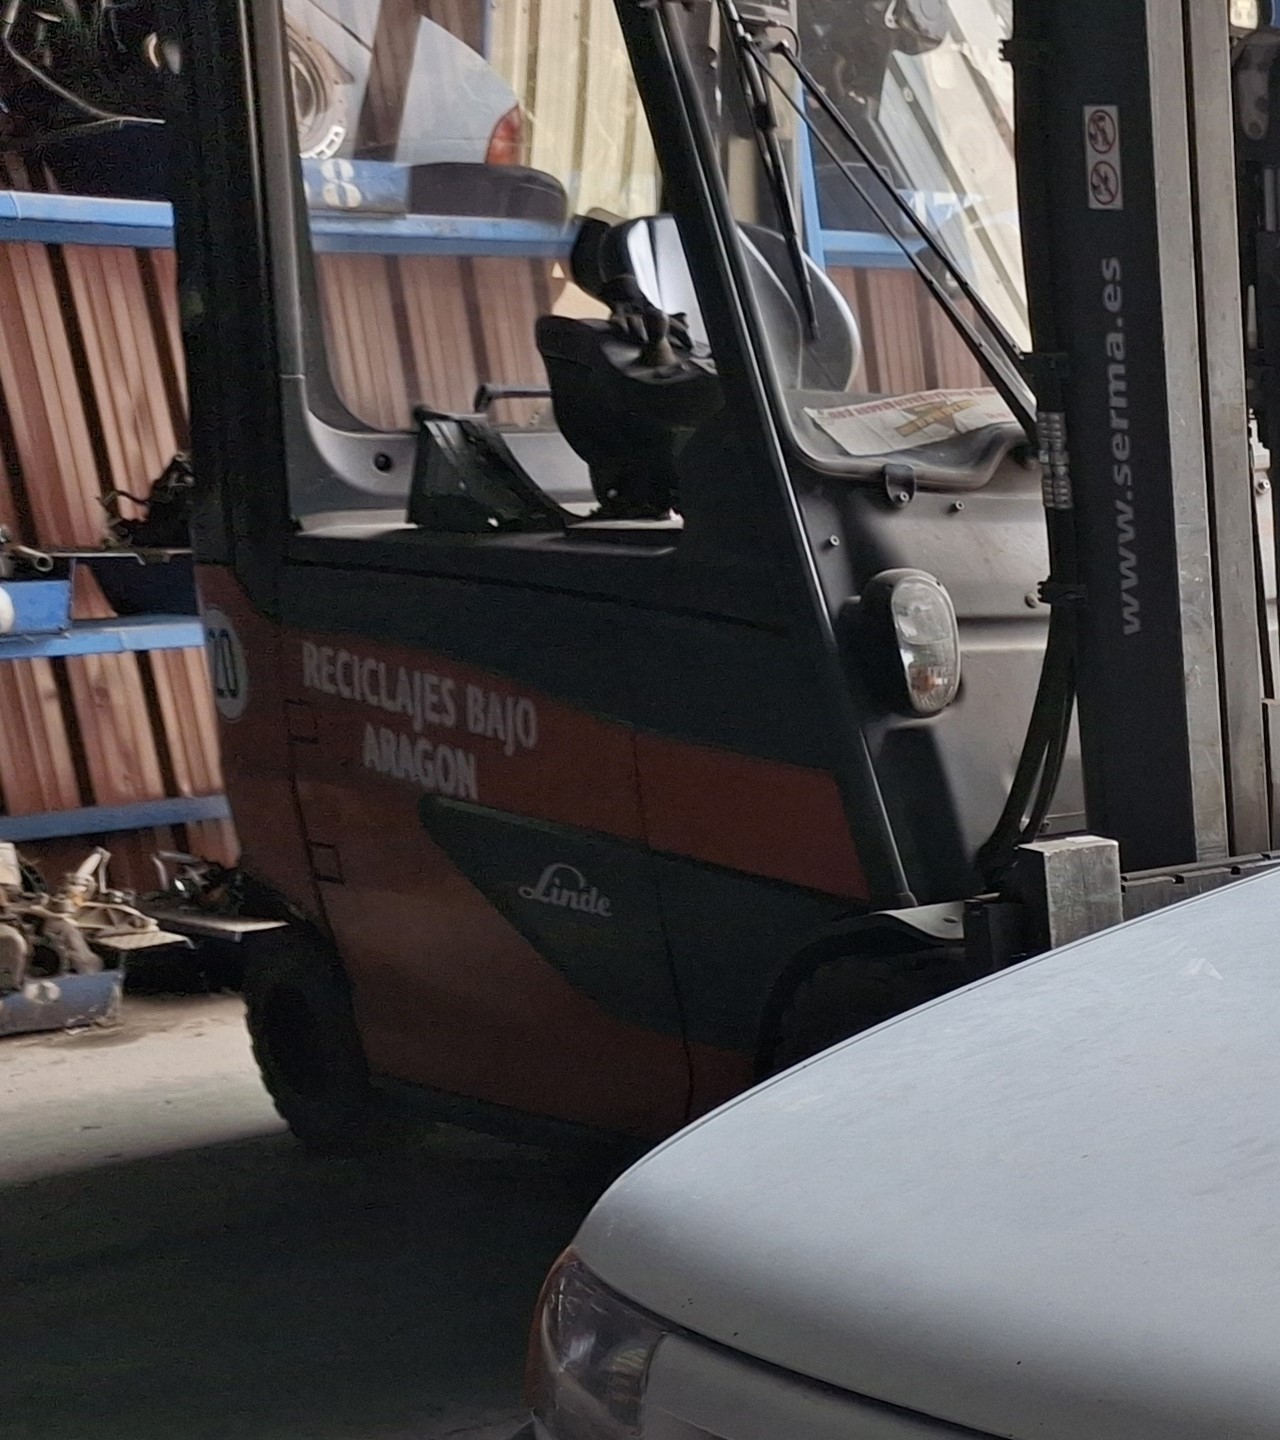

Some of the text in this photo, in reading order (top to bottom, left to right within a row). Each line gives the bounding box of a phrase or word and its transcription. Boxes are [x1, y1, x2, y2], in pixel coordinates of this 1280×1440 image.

[1101, 256, 1142, 636] www.serma.es
[301, 640, 538, 757] RECICLAJES BAJO
[362, 721, 479, 800] ARAGON
[517, 861, 614, 917] Linde
